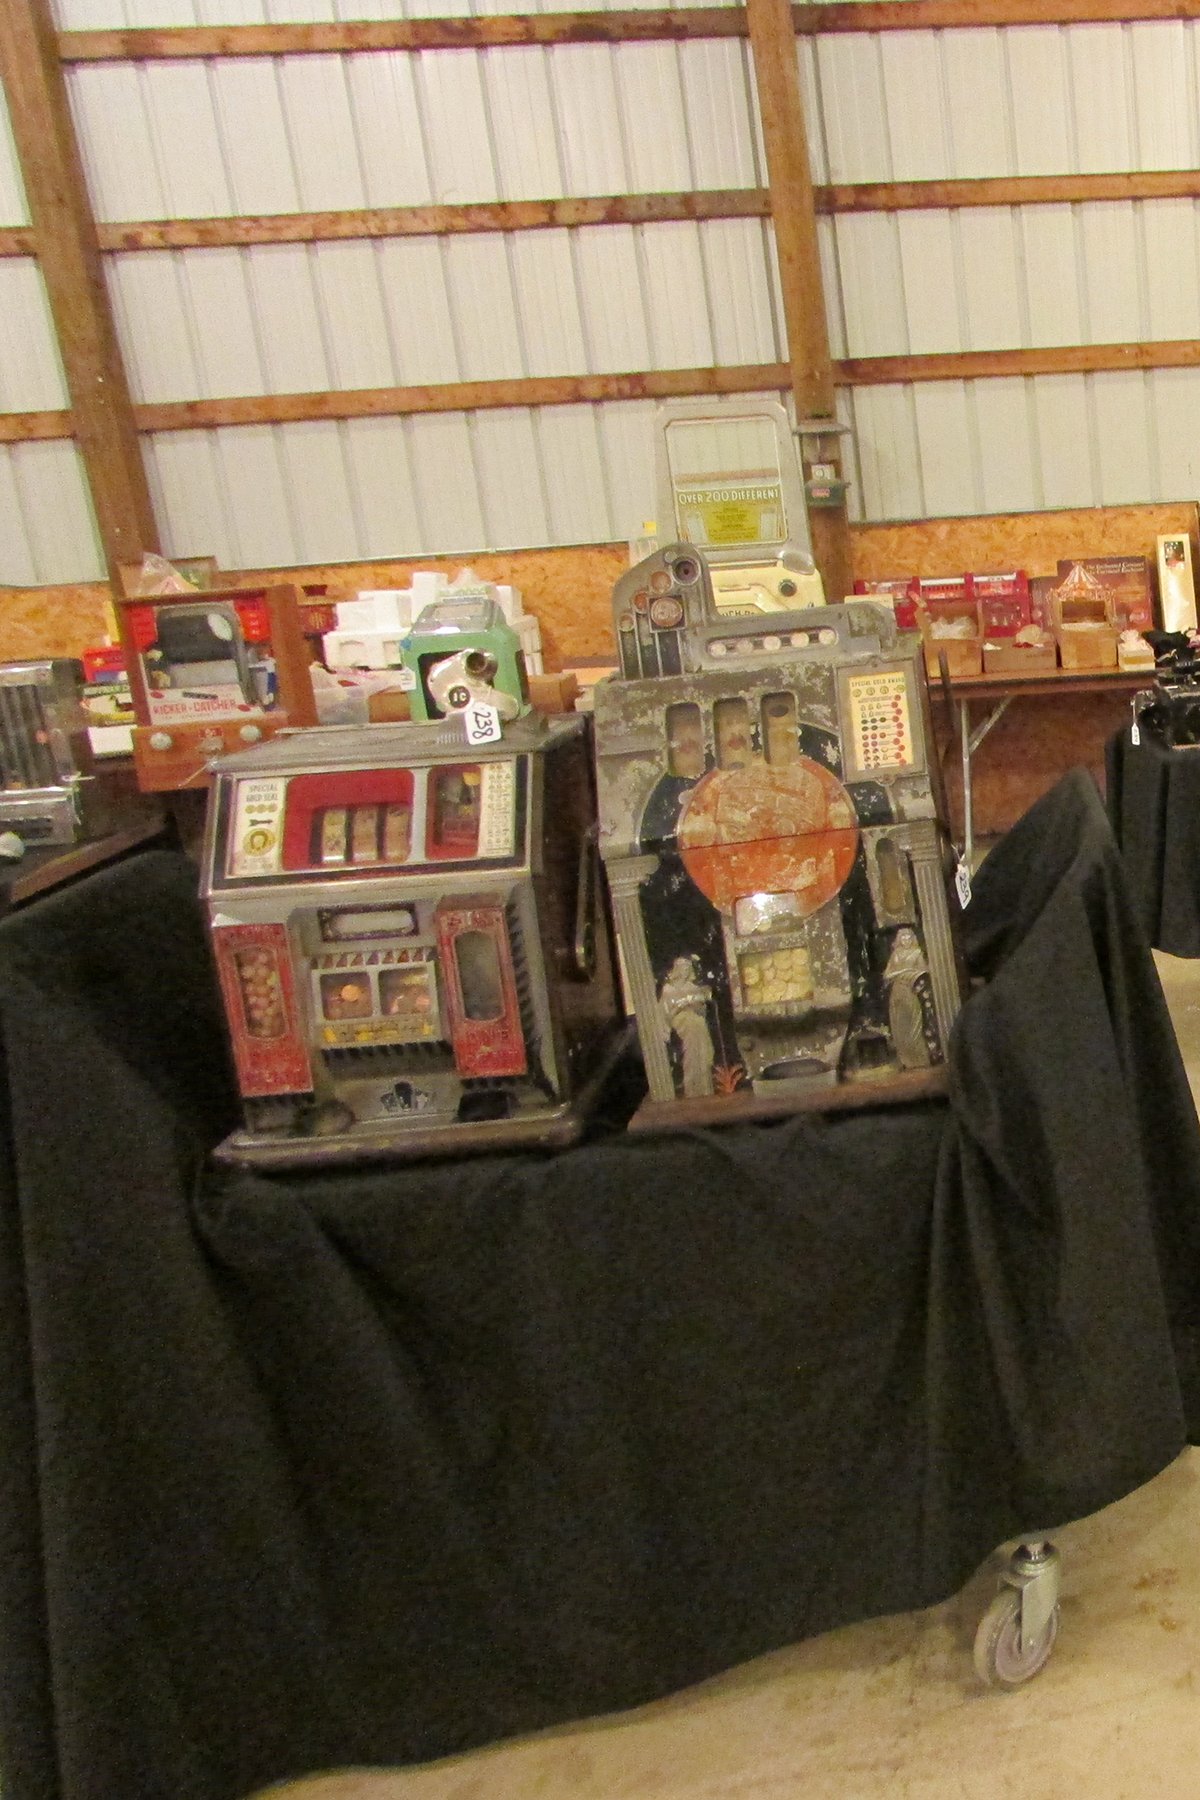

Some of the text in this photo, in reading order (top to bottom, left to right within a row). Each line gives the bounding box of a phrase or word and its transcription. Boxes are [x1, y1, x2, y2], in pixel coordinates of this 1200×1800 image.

[679, 487, 780, 505] OVER 200 DIFFERENT
[472, 711, 494, 740] 238
